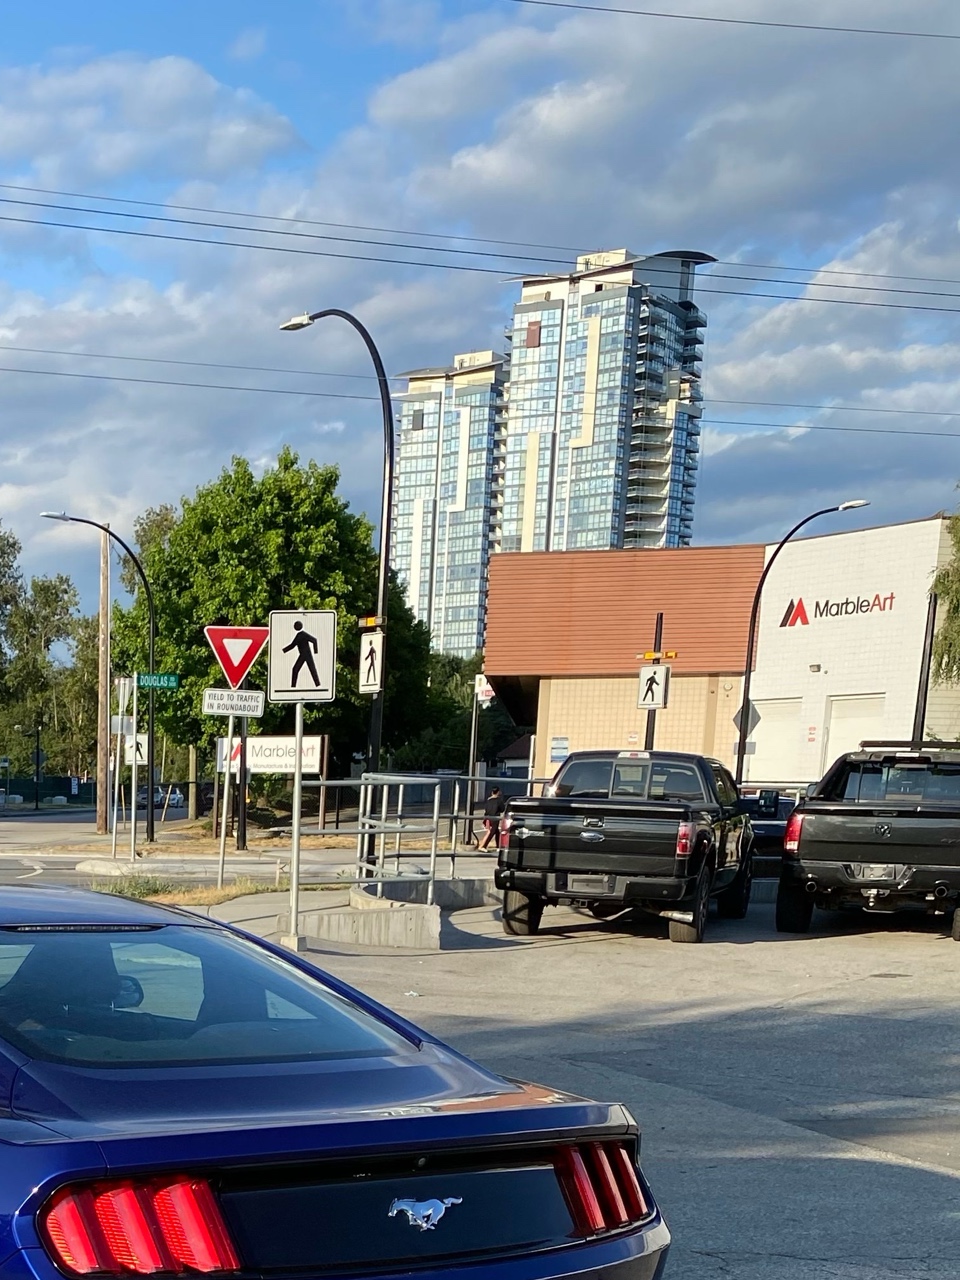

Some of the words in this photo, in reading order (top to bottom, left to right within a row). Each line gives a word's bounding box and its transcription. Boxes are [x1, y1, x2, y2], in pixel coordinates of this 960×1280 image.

[814, 592, 896, 618] MarbleArt
[140, 675, 168, 687] DOUGLAS
[208, 692, 224, 701] YIELD
[227, 693, 235, 702] TO
[236, 694, 260, 704] TRAFFIC
[207, 702, 214, 710] IN
[216, 703, 259, 713] ROUNDABOUT
